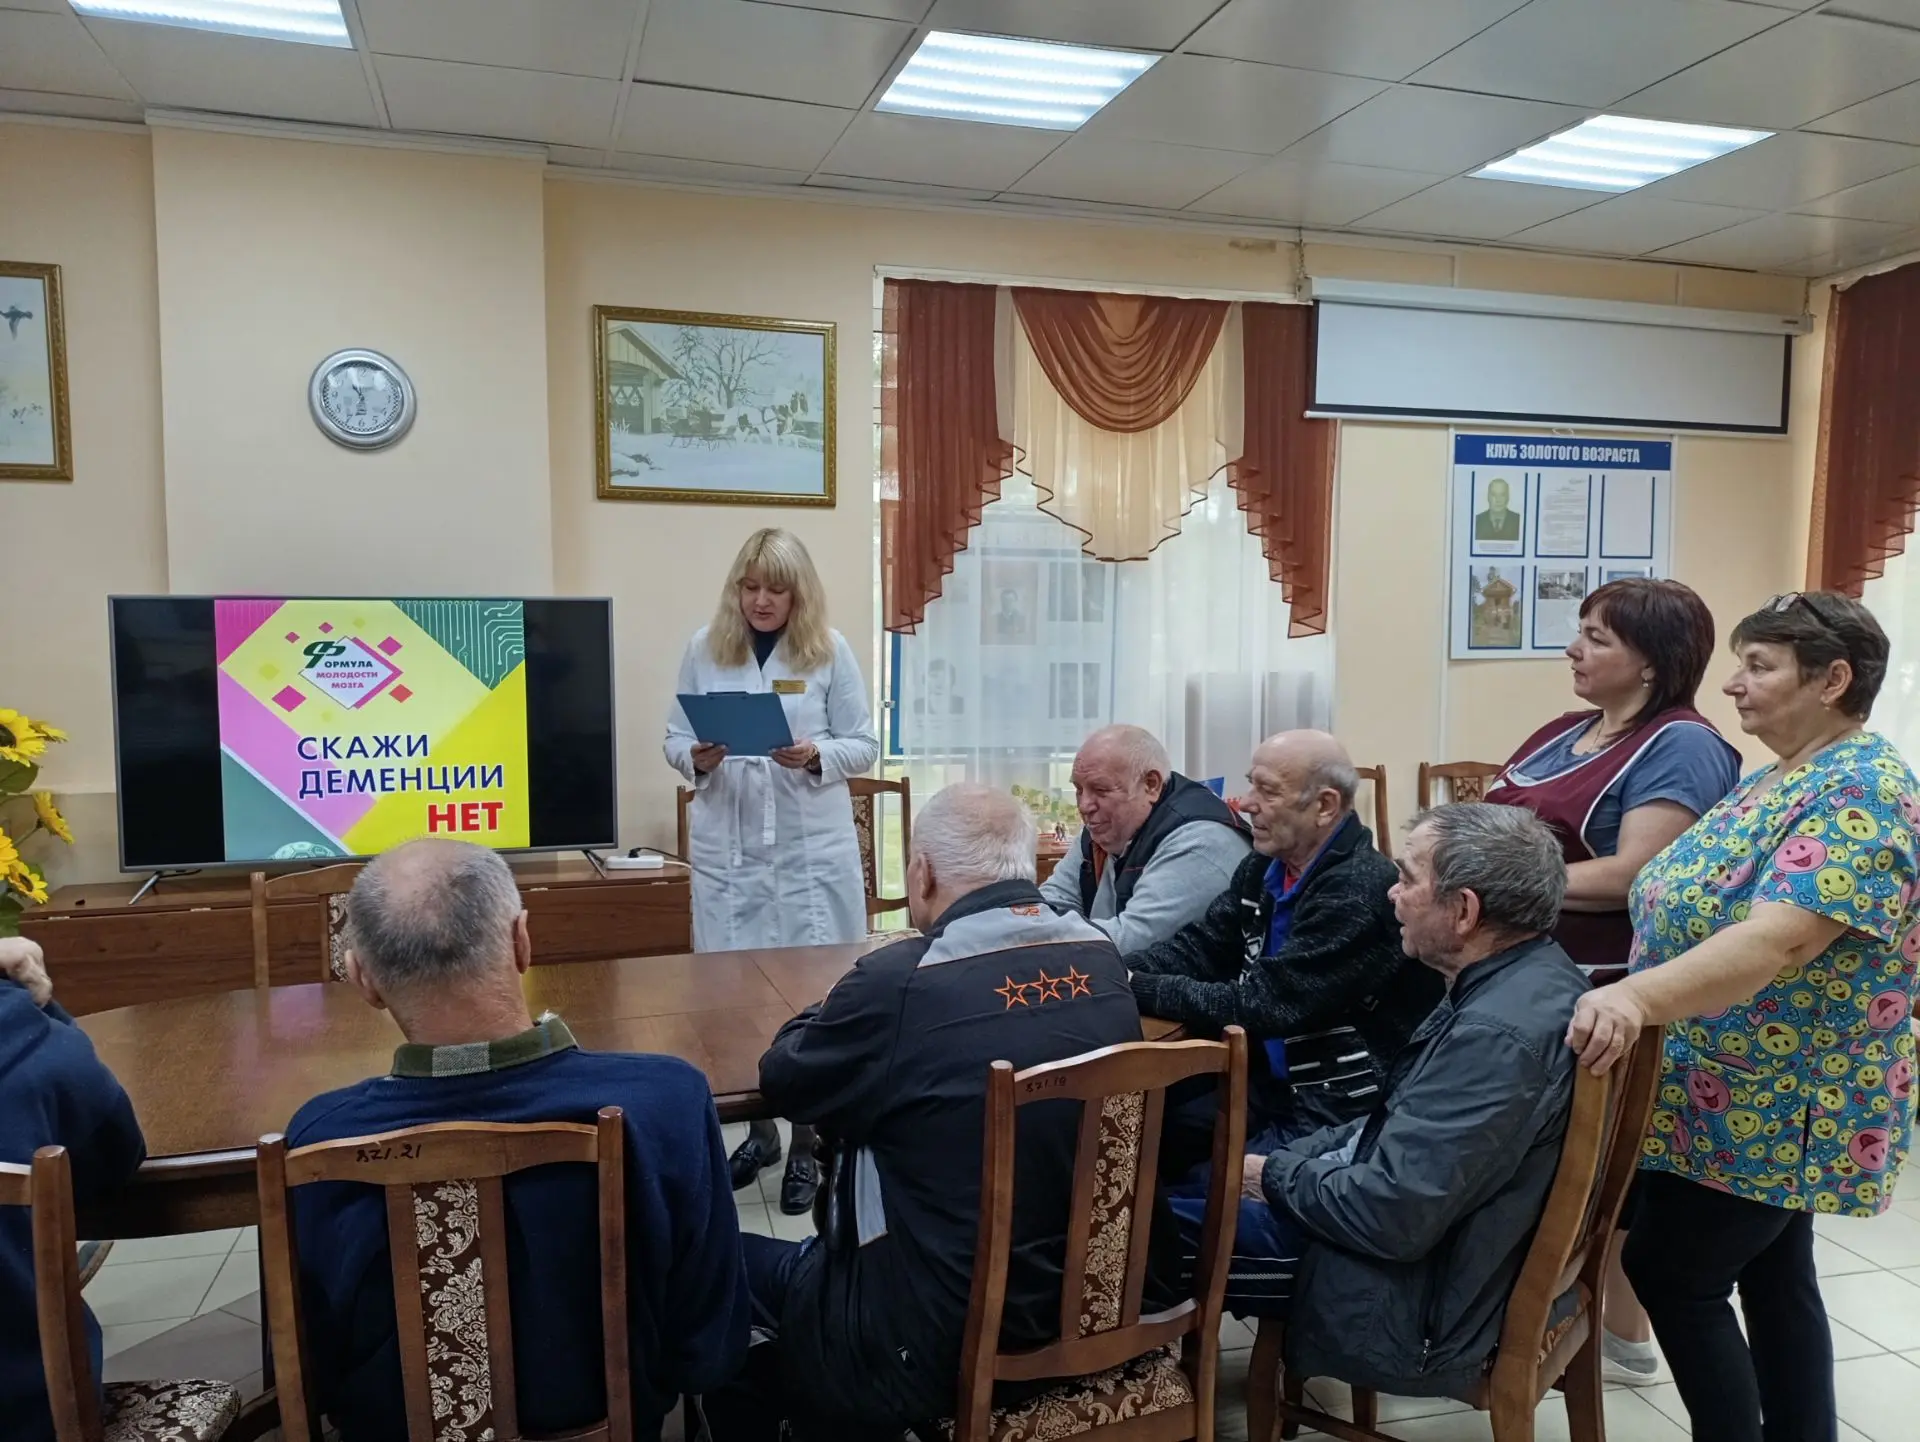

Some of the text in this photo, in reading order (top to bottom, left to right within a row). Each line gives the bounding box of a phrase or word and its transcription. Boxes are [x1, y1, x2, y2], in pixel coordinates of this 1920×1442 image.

[359, 419, 365, 427] 6
[372, 416, 378, 424] 5
[1486, 443, 1640, 463] КЛУБ ЗОЛОТОГО ВОЗРАСТА
[316, 670, 378, 679] МОЛОДОСТИ
[331, 681, 364, 689] МОЗГА
[297, 734, 428, 760] СКАЖИ
[299, 765, 503, 800] ДЕМЕНЦИИ
[428, 802, 503, 833] НЕТ
